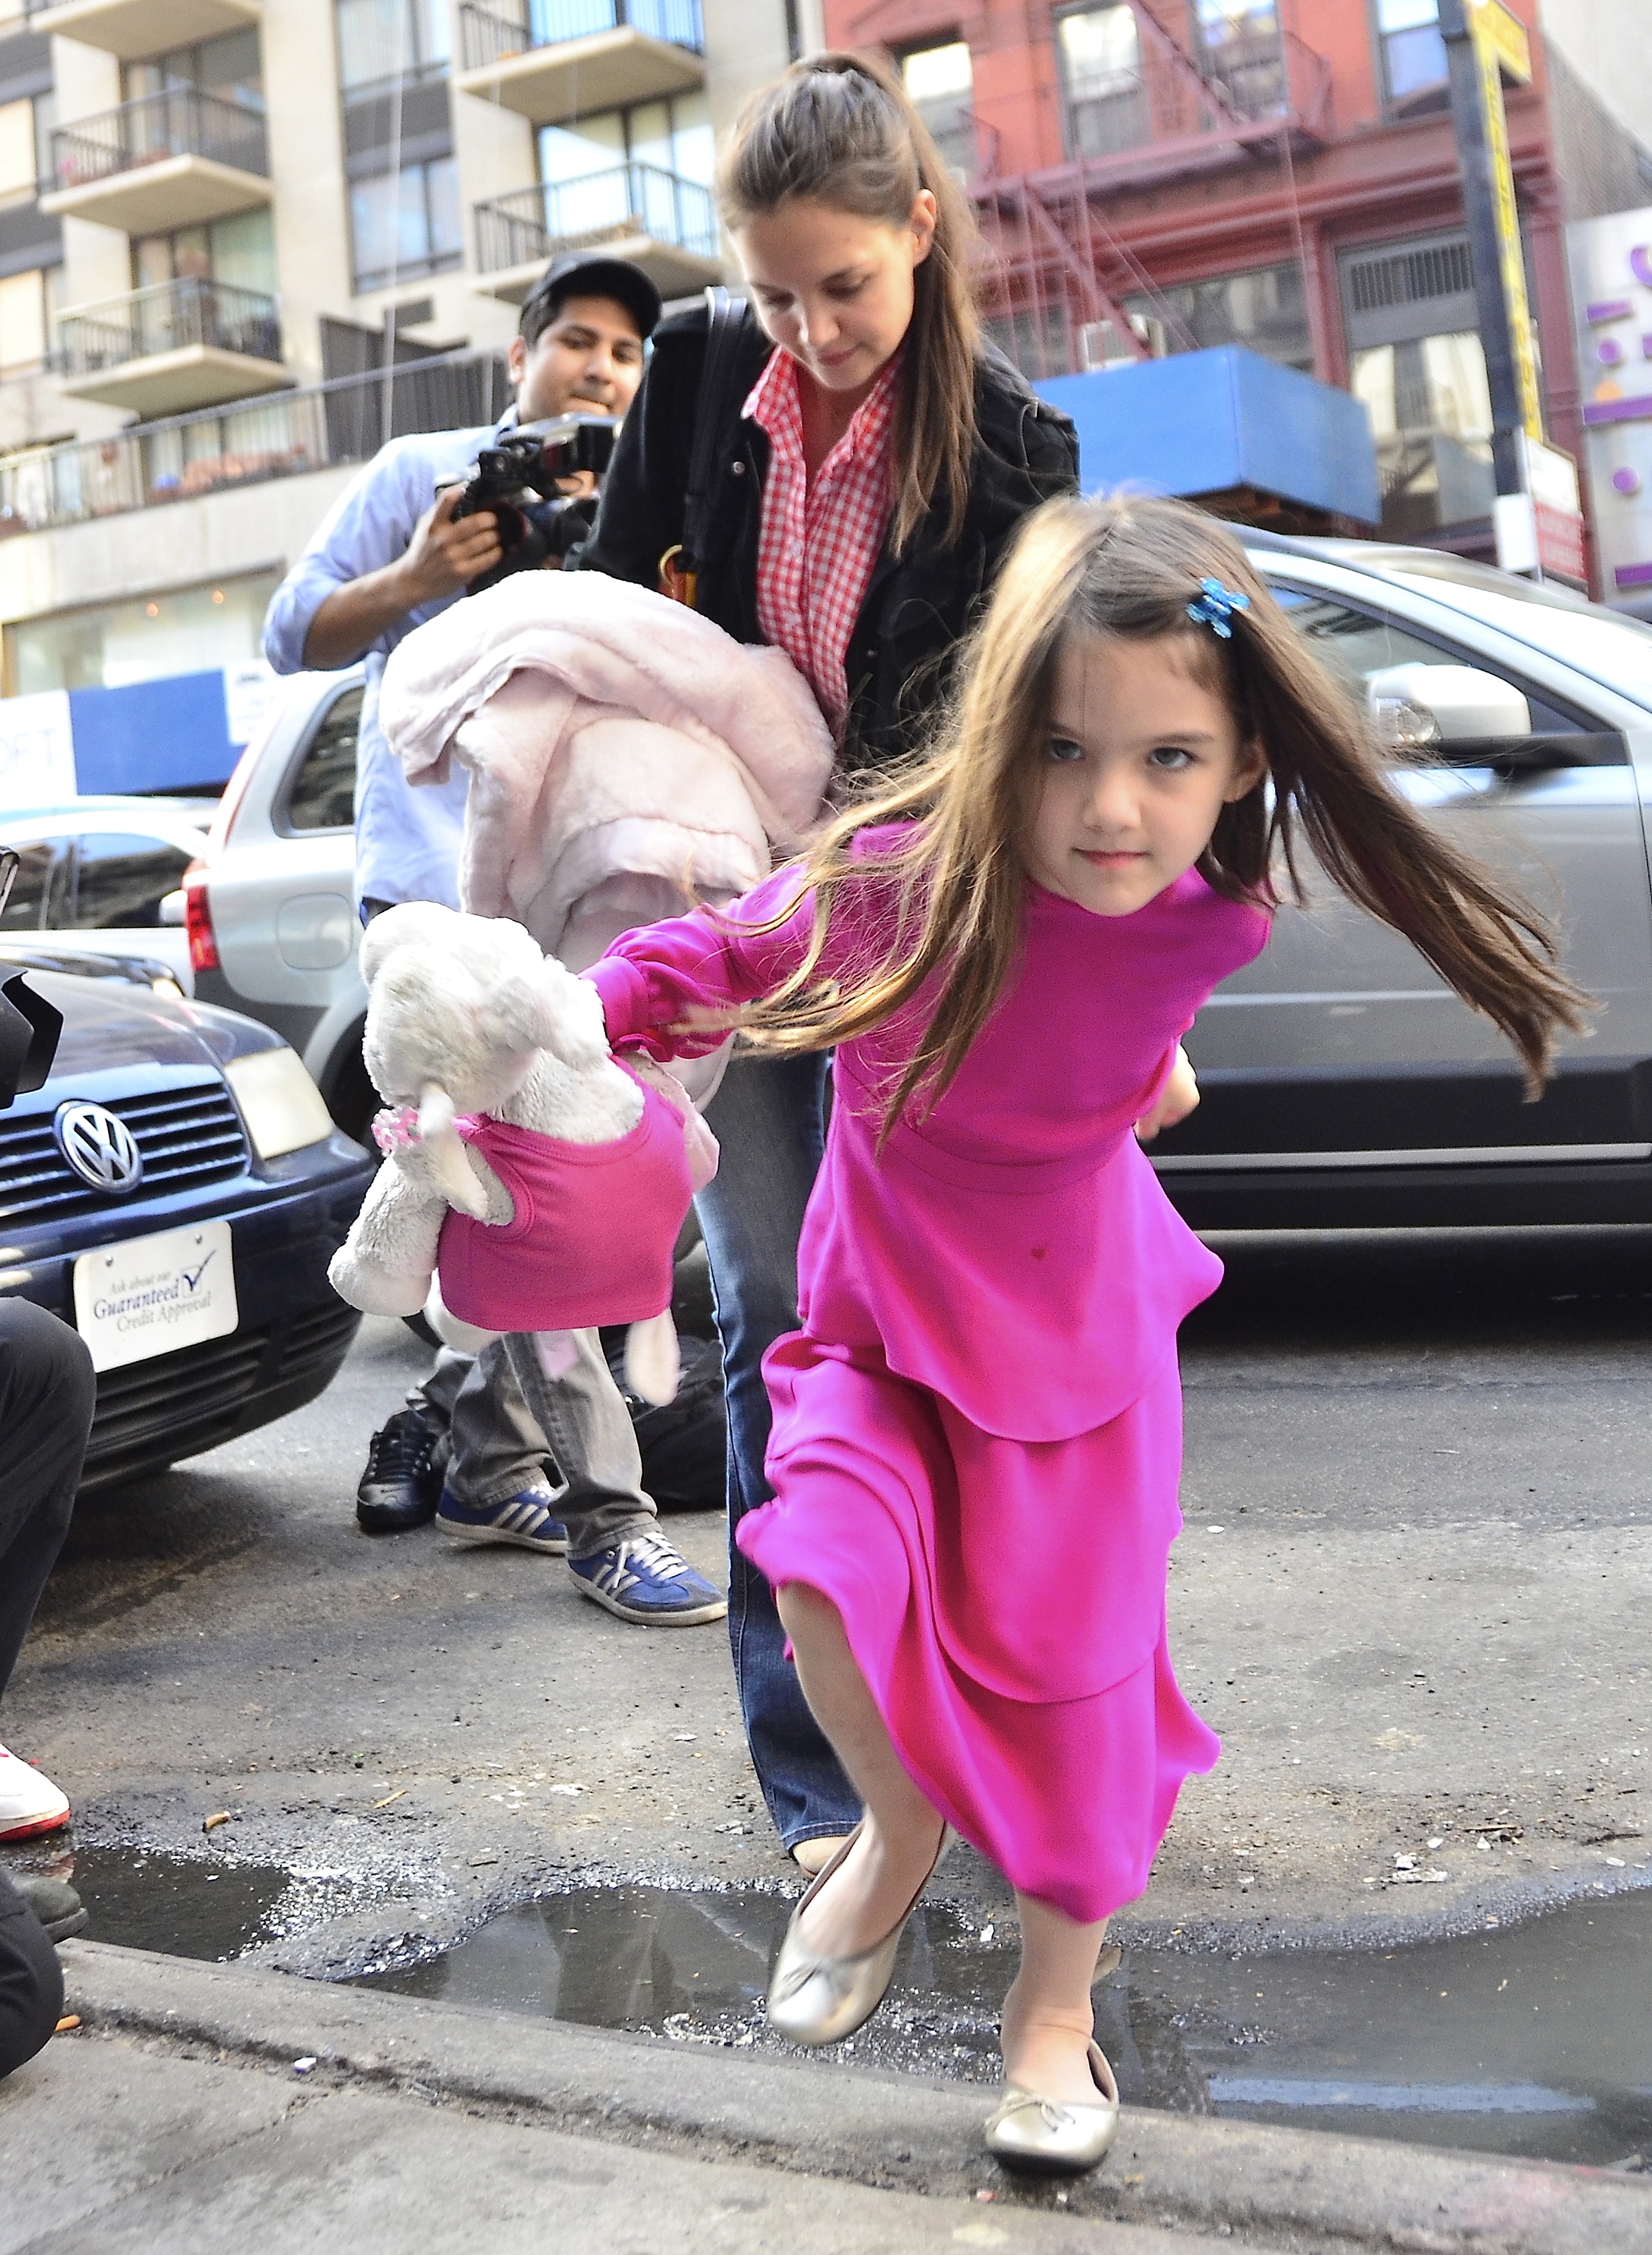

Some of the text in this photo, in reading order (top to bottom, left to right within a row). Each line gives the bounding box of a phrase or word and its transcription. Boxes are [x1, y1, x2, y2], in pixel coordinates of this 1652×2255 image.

[94, 1278, 179, 1319] Guaranteed
[110, 1280, 126, 1295] Ask
[129, 1275, 154, 1289] about
[117, 1290, 211, 1333] Credit Approval
